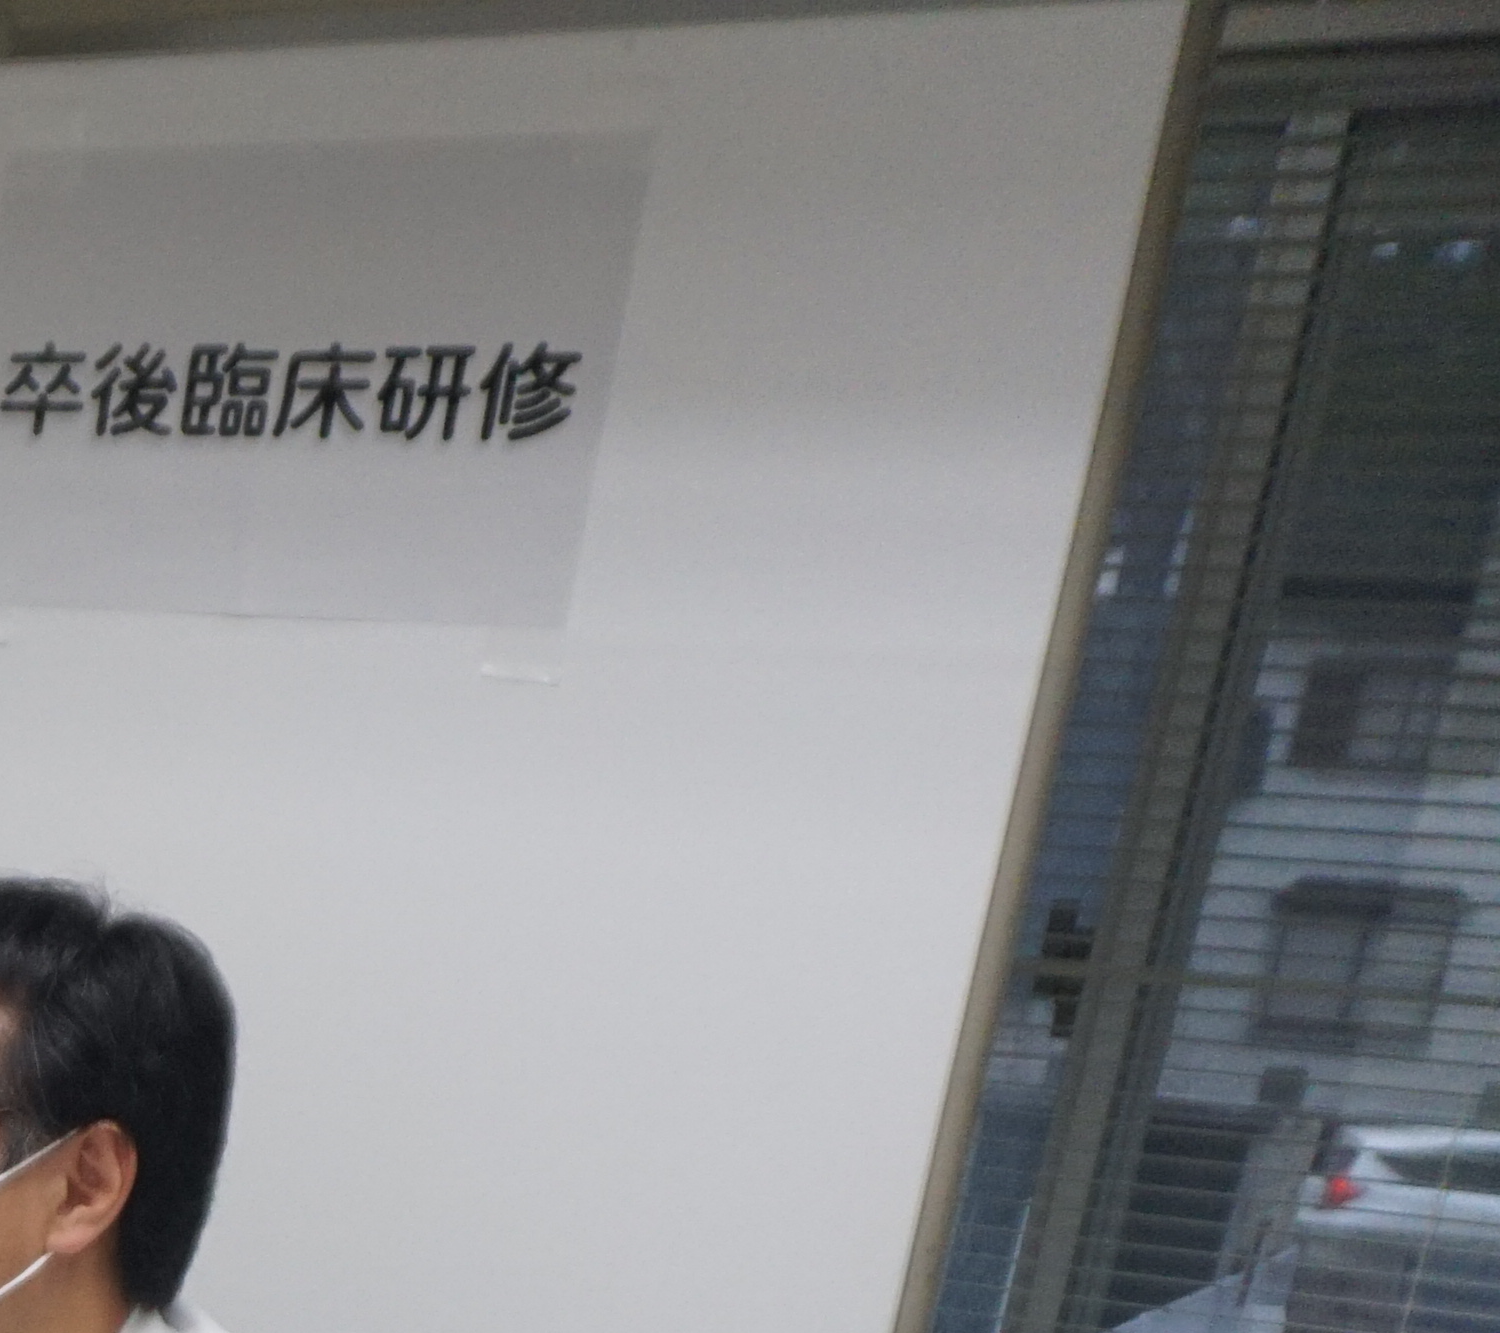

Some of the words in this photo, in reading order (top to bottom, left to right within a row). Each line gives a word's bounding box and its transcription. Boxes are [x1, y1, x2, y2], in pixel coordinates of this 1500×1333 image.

[0, 341, 583, 441] 卒後臨床研修
